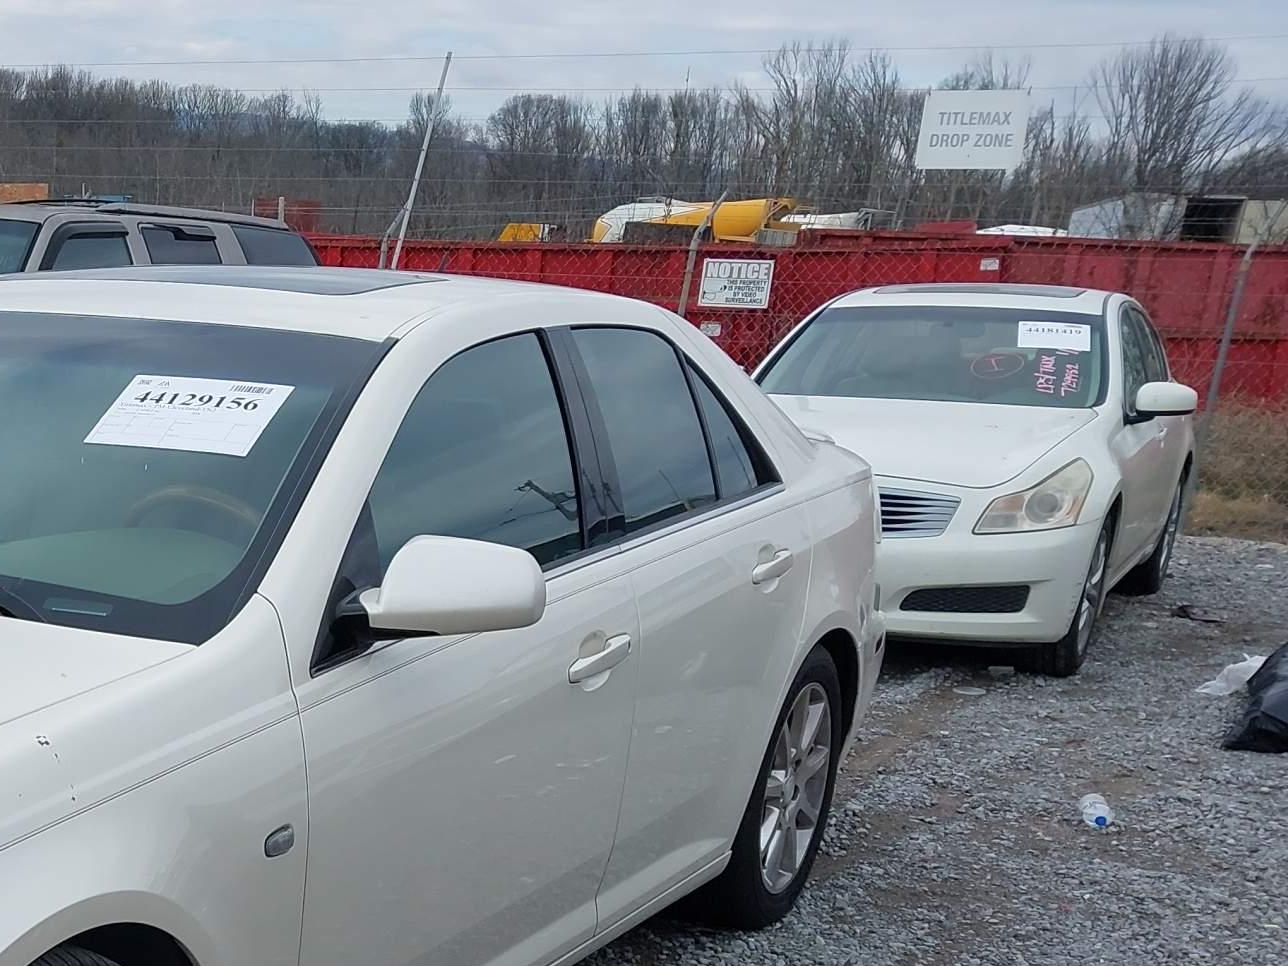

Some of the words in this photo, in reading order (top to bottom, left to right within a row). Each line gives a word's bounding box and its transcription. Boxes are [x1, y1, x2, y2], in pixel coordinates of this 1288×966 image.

[938, 111, 1012, 126] TITLEMAX
[929, 133, 970, 148] DROP
[973, 133, 1014, 148] ZONE
[707, 263, 769, 279] NOTICE
[134, 391, 262, 411] 44129156
